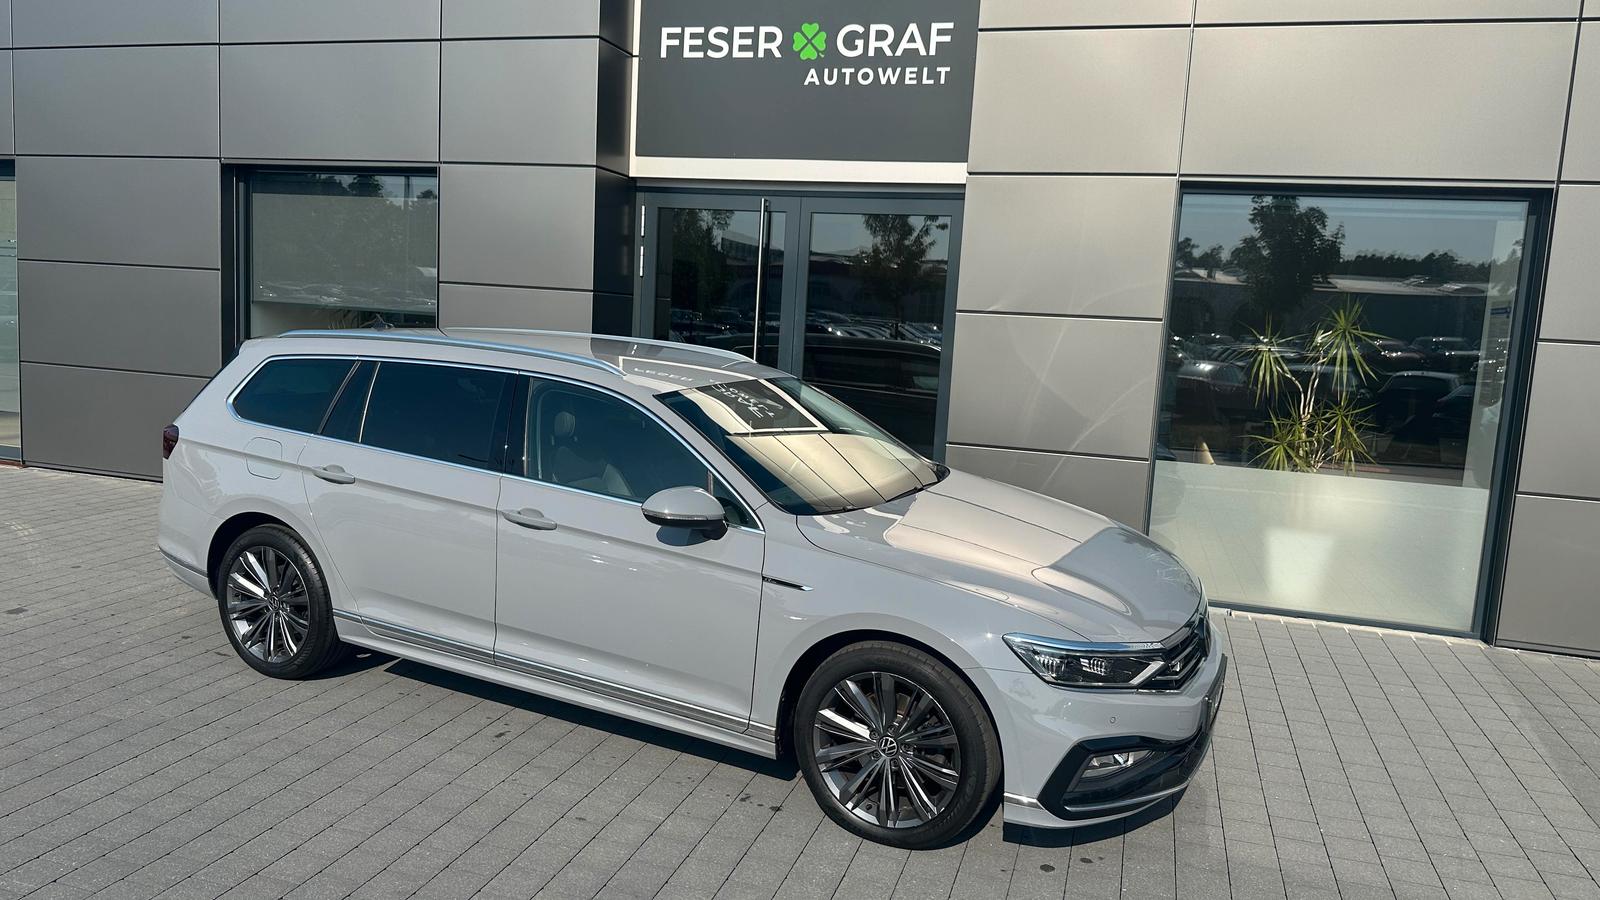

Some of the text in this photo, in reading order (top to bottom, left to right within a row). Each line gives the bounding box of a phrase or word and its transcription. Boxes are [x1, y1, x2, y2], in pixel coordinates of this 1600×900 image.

[661, 22, 954, 58] FESER GRAF
[804, 67, 950, 85] AUTOWELT
